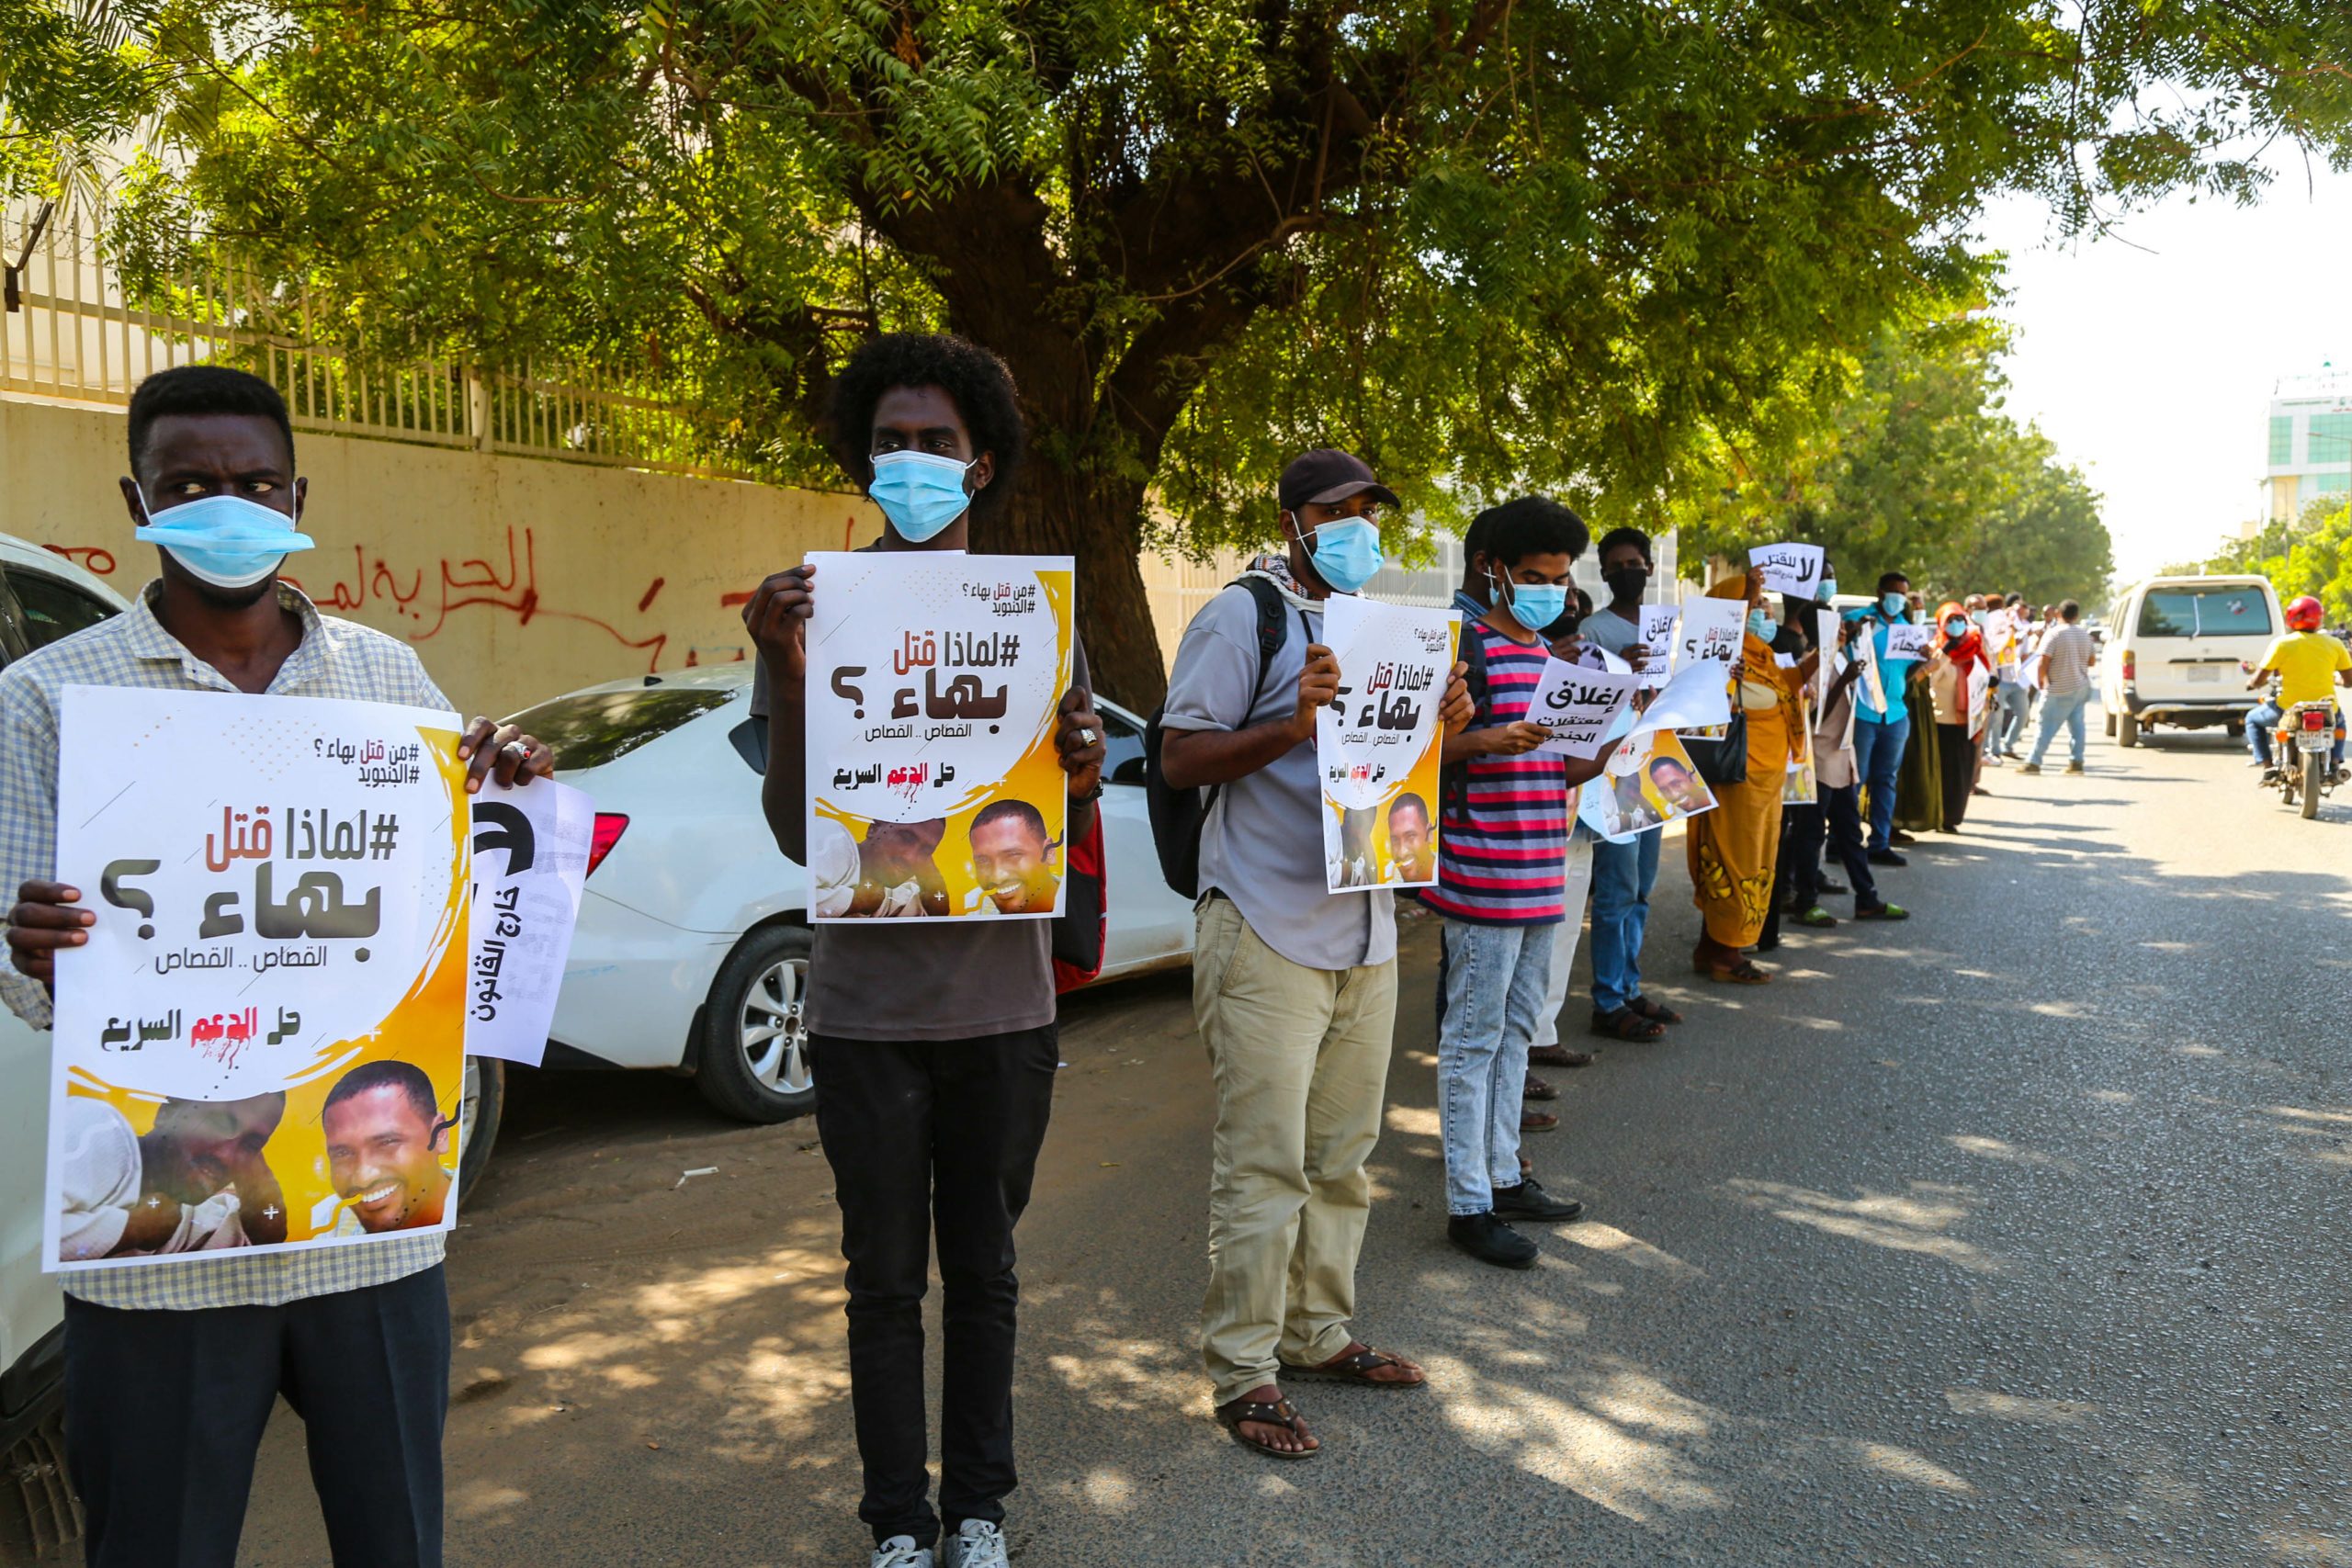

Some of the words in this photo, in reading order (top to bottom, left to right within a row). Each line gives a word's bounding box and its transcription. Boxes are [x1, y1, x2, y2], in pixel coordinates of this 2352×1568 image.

[1764, 552, 1796, 568] للقتل
[1796, 557, 1815, 582] لا
[993, 582, 1011, 601] قتل
[1645, 615, 1674, 642] إغلاق
[893, 630, 936, 676] قتل
[944, 631, 1020, 667] #لماذا
[1367, 661, 1394, 695] قتل
[1394, 663, 1434, 691] #لماذا
[891, 667, 1008, 735] بهاء
[1545, 680, 1624, 714] إغلاق
[1357, 690, 1421, 742] بهاء
[1536, 716, 1603, 728] معتقلات
[865, 724, 913, 742] القصاص
[924, 724, 971, 741] القصاص
[326, 738, 356, 764] بهاء
[360, 739, 384, 764] قتل
[390, 743, 420, 765] #من
[358, 763, 420, 788] #الجنجويد
[832, 763, 882, 791] السريع
[206, 806, 272, 873] قتل
[286, 807, 400, 860] #لماذا
[198, 861, 381, 963] بهاء
[493, 886, 522, 938] خارج
[155, 946, 233, 975] القصاص
[253, 945, 327, 974] القصاص
[470, 939, 507, 1022] القانون
[101, 1009, 181, 1052] السريع
[191, 1006, 258, 1048] الدعم
[266, 1006, 301, 1045] حل
